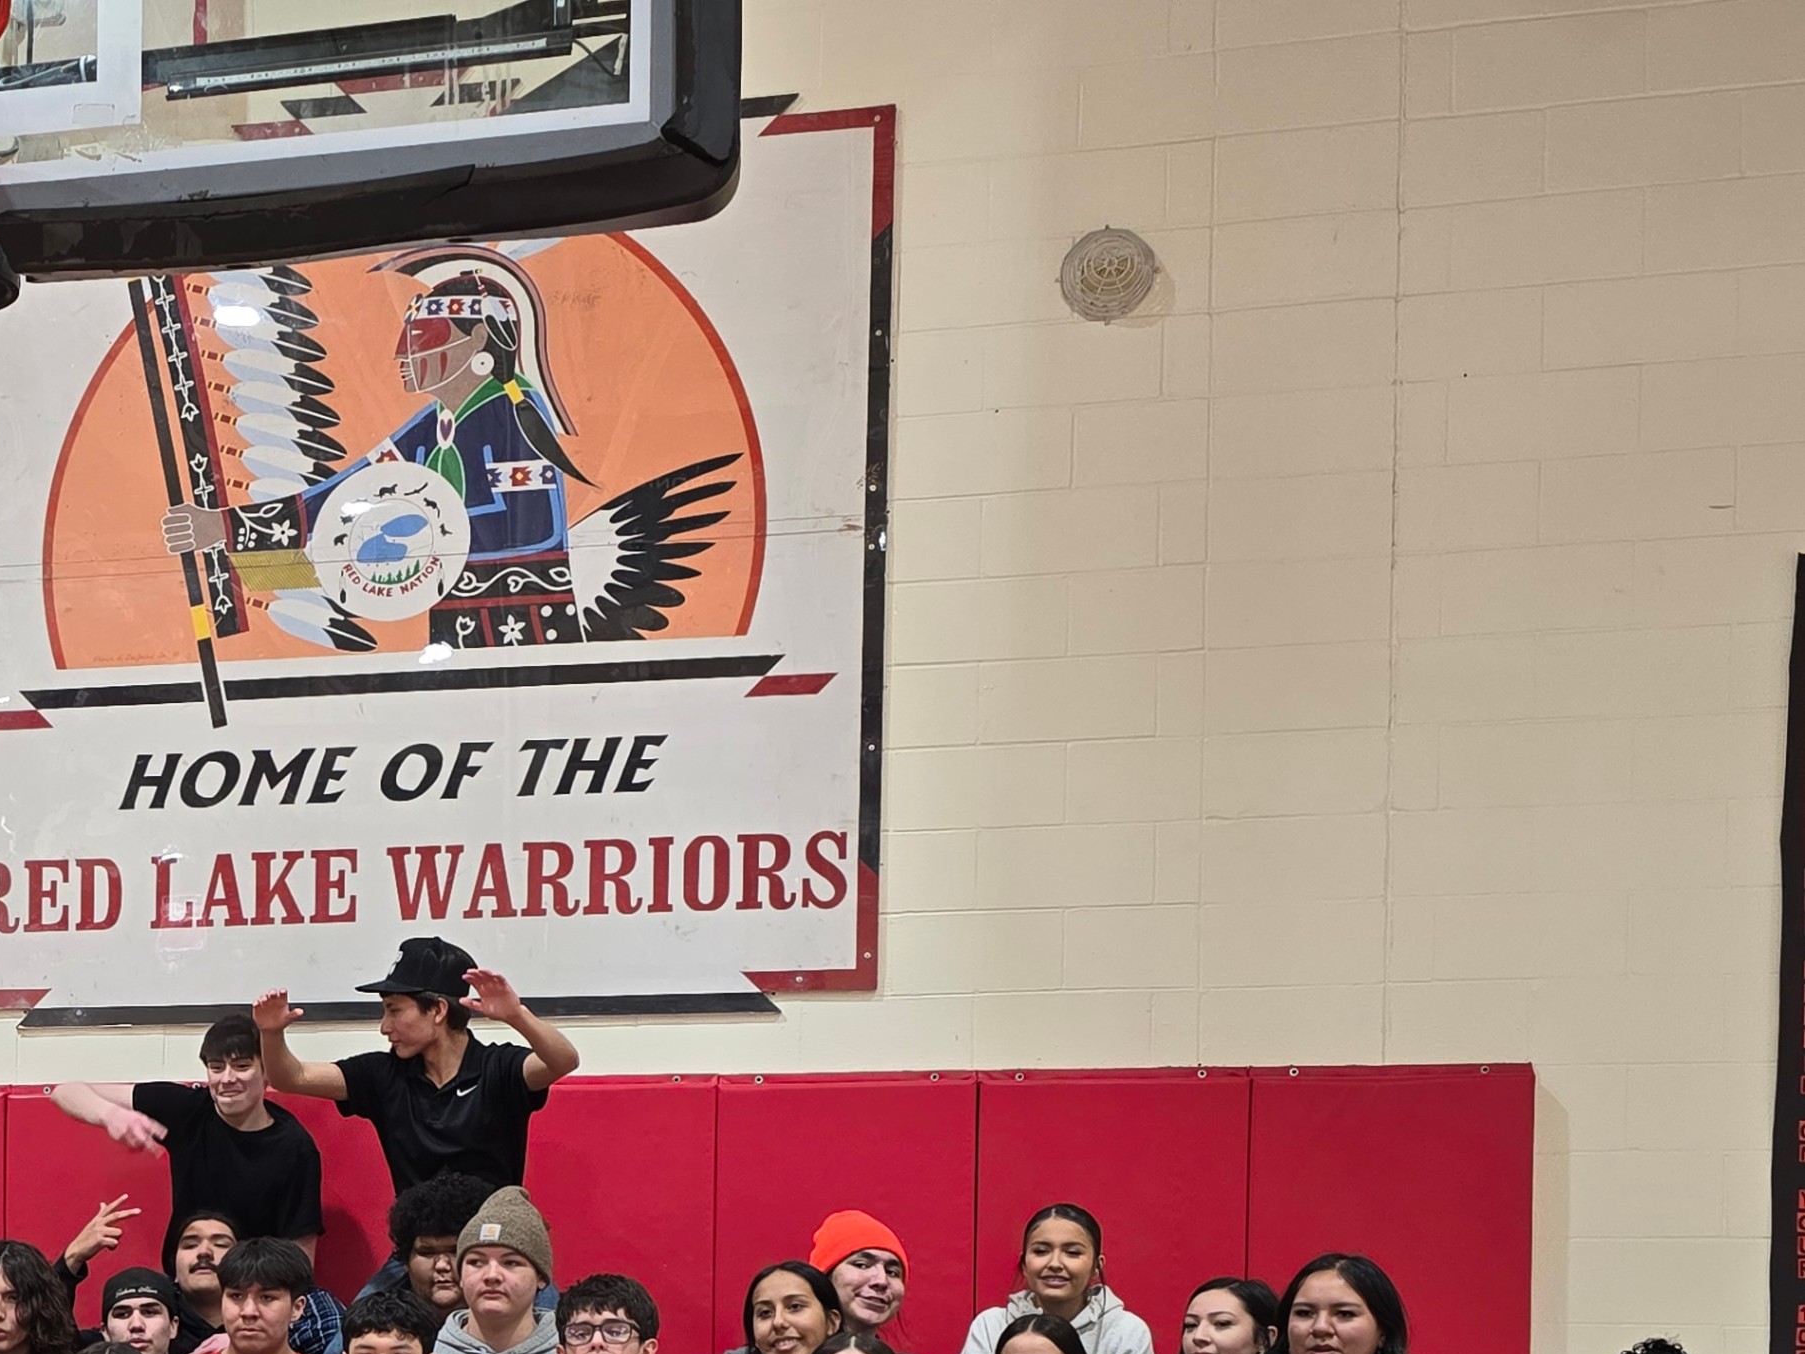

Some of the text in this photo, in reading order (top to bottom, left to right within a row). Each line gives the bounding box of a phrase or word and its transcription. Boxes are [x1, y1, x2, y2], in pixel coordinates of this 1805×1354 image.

[343, 556, 440, 597] RED LAKE NATION
[117, 734, 668, 810] HOME OF THE
[151, 849, 358, 930] LAKE
[385, 830, 848, 921] WARRIORS
